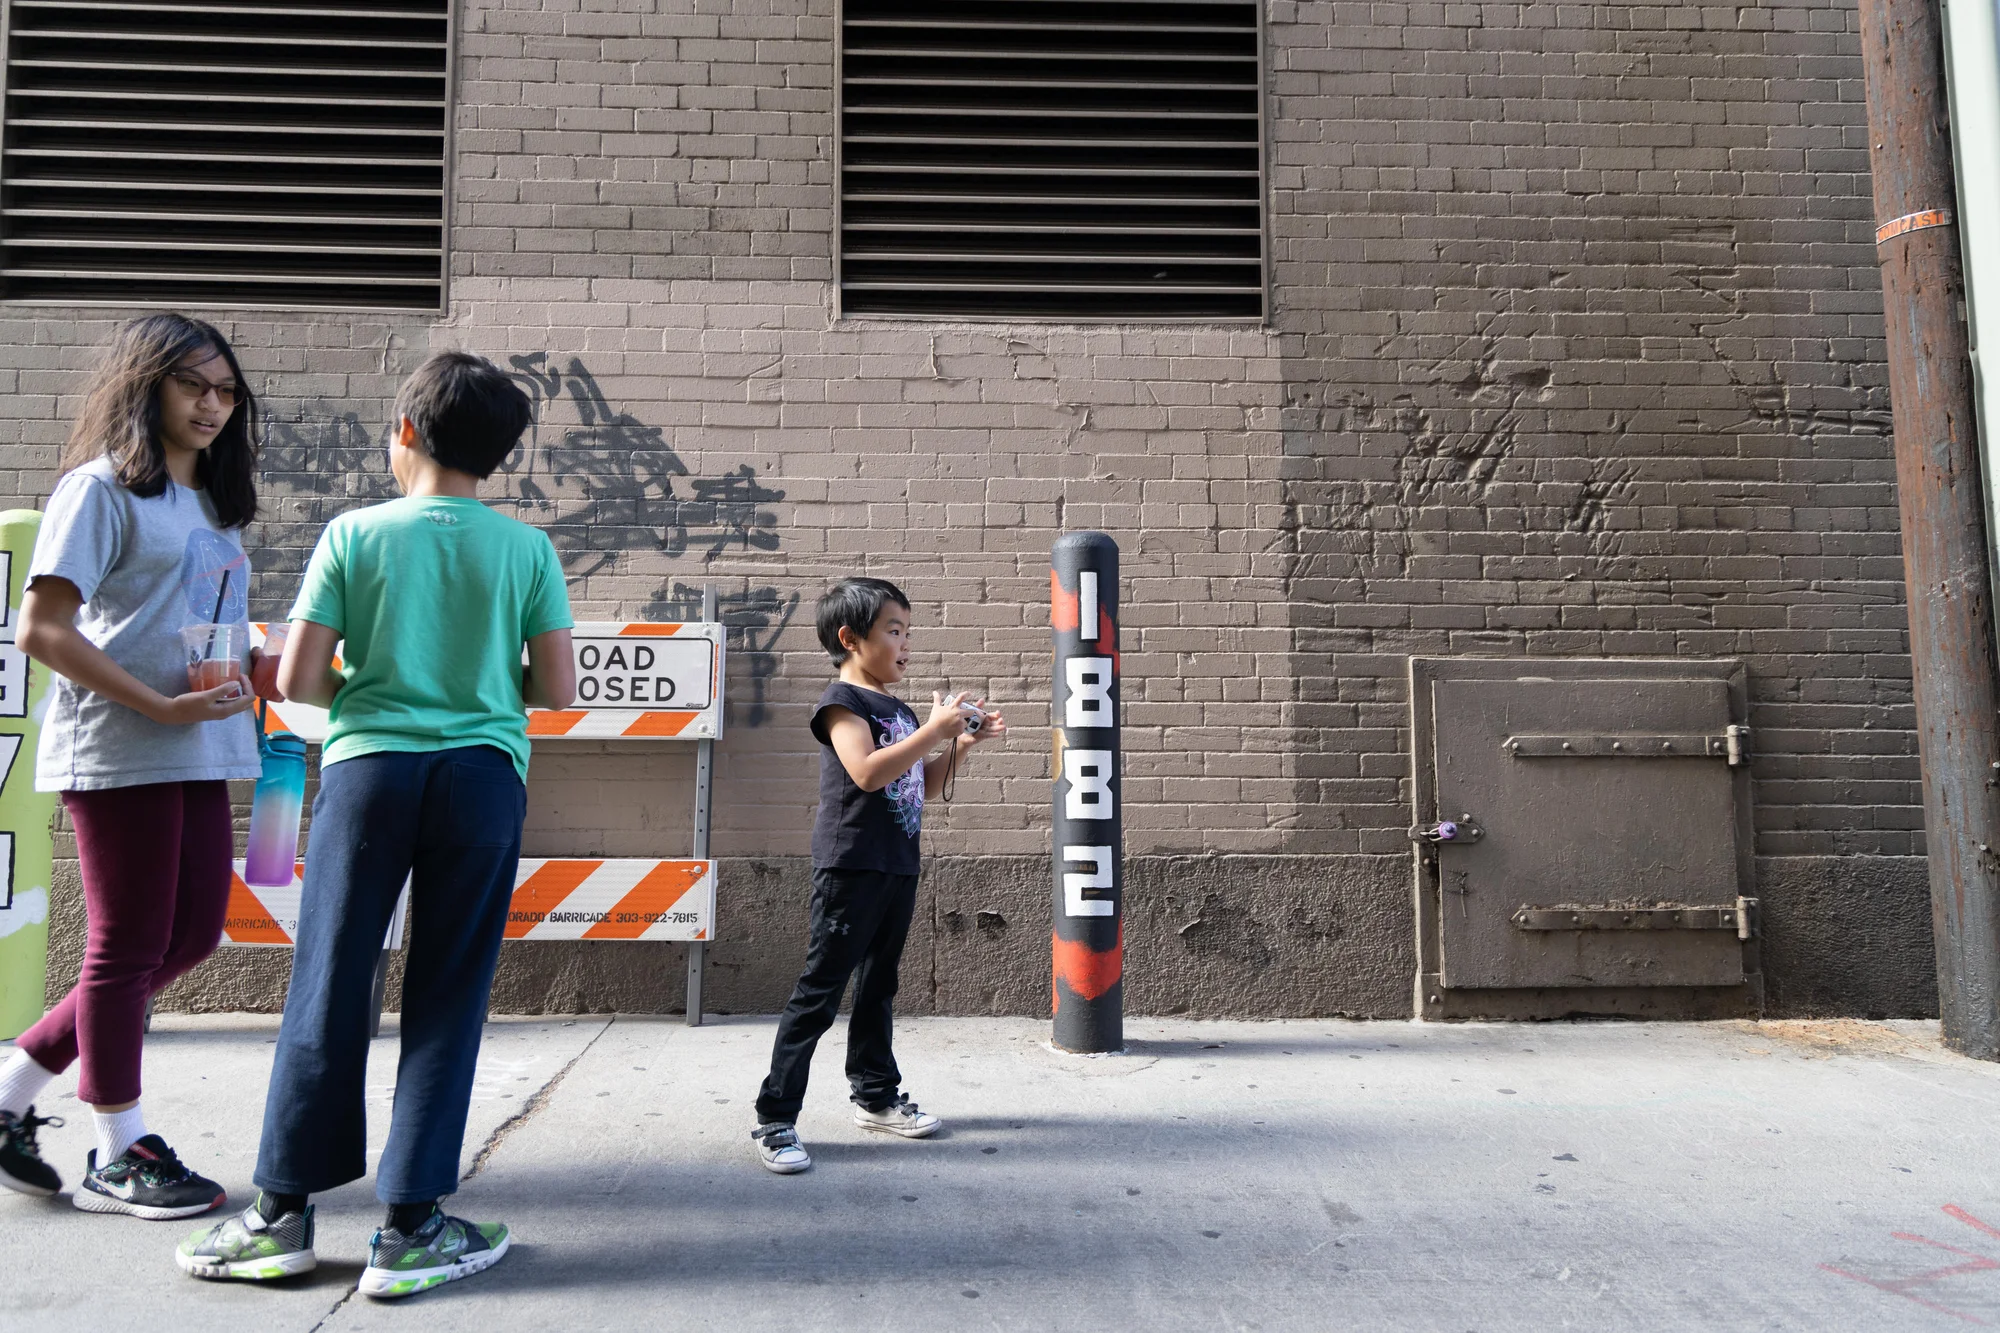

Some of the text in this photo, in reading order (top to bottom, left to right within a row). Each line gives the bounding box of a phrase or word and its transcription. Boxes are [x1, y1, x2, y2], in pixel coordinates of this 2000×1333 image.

[1878, 212, 1944, 241] COMCAST
[579, 645, 655, 671] OAD
[578, 675, 676, 702] OSED
[1063, 572, 1115, 918] 1882
[224, 918, 283, 930] ARRICADE
[508, 911, 698, 923] ORADO BARRICADE 303-922-7815
